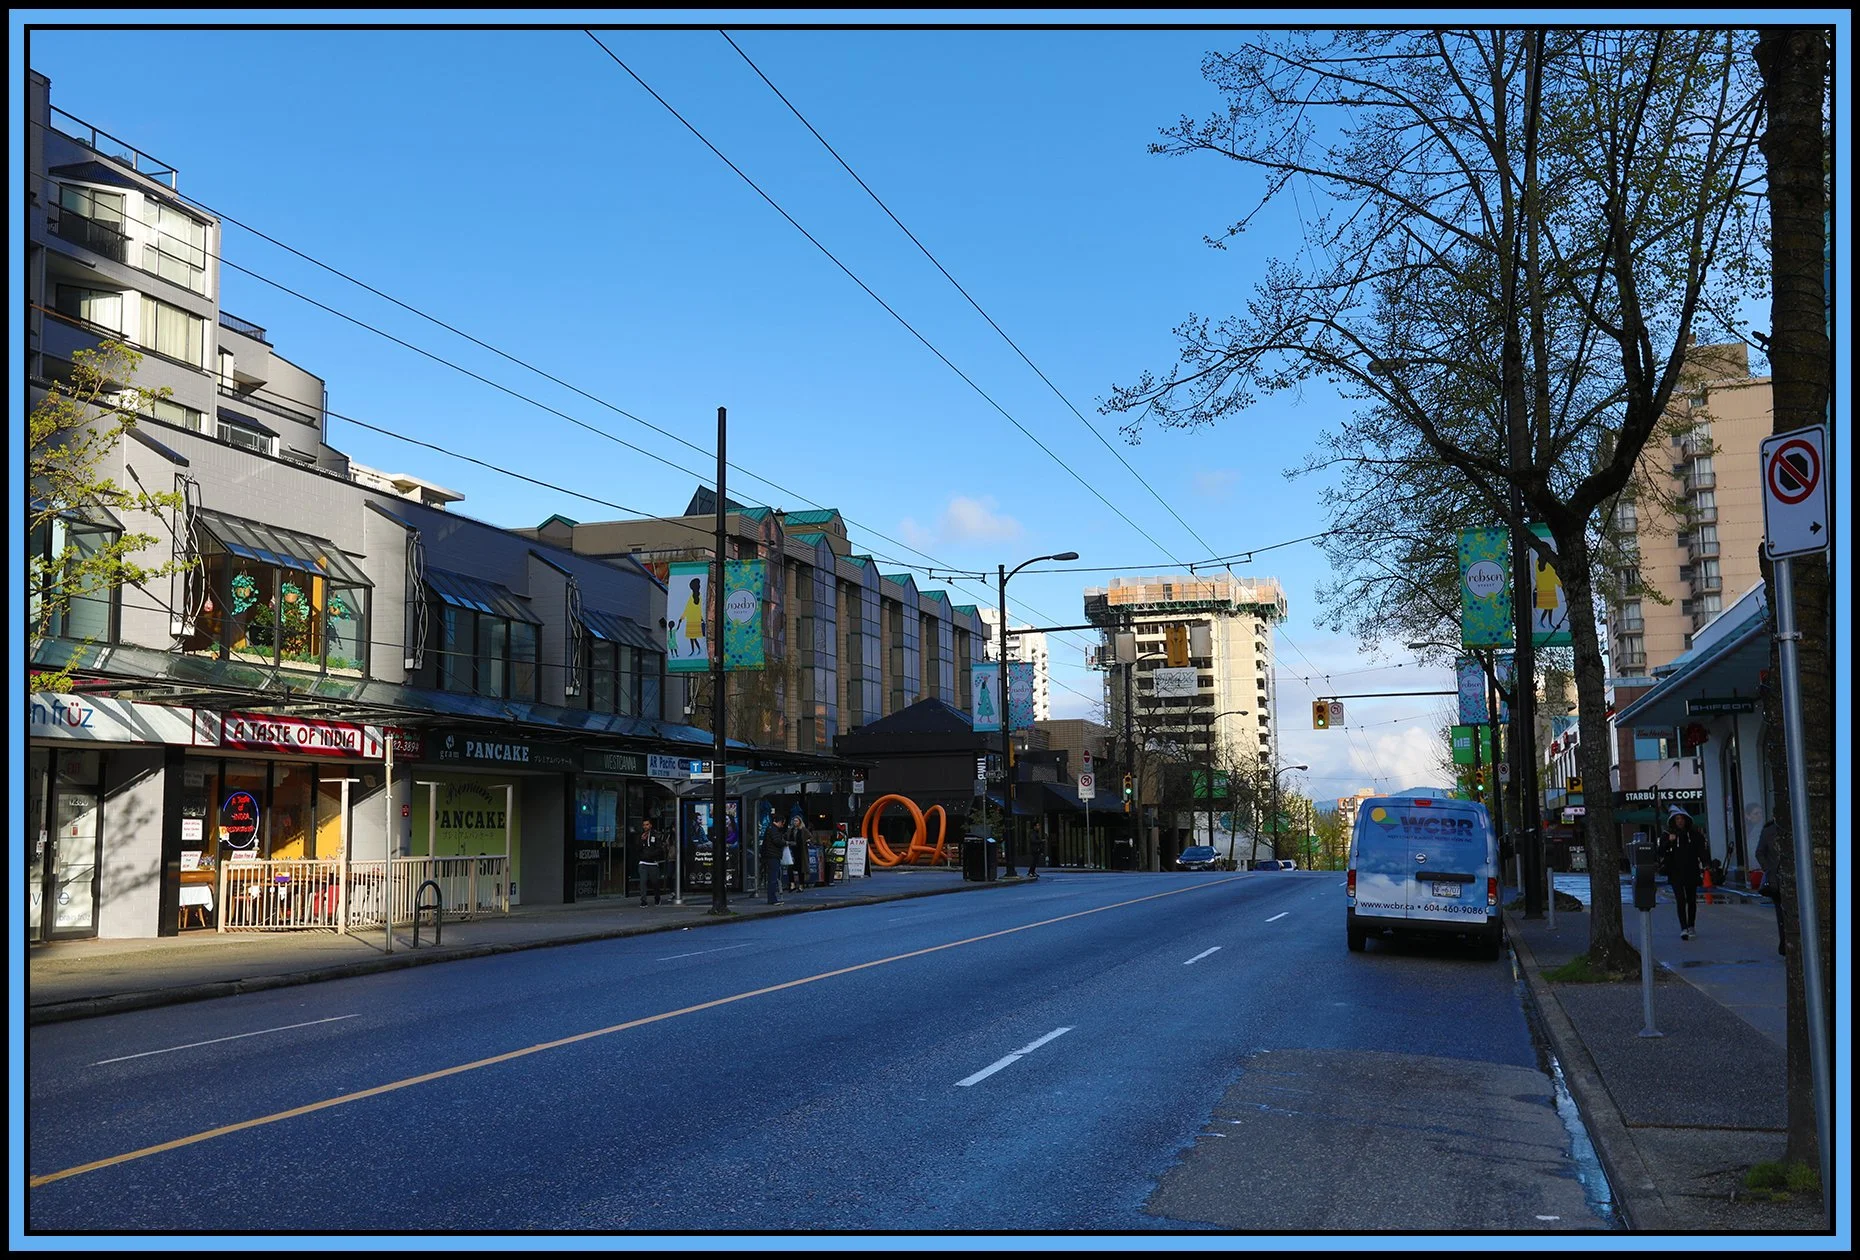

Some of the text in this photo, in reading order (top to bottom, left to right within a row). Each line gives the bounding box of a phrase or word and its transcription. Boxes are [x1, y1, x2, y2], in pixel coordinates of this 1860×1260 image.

[1468, 569, 1505, 583] robson
[234, 722, 356, 748] A TASTE OF INDIA
[465, 740, 529, 763] PANCAKE
[1625, 790, 1703, 801] STARBUKS COFF
[1400, 815, 1474, 837] WCBR
[1360, 901, 1484, 916] www.wcbr.ca 604-460-9086
